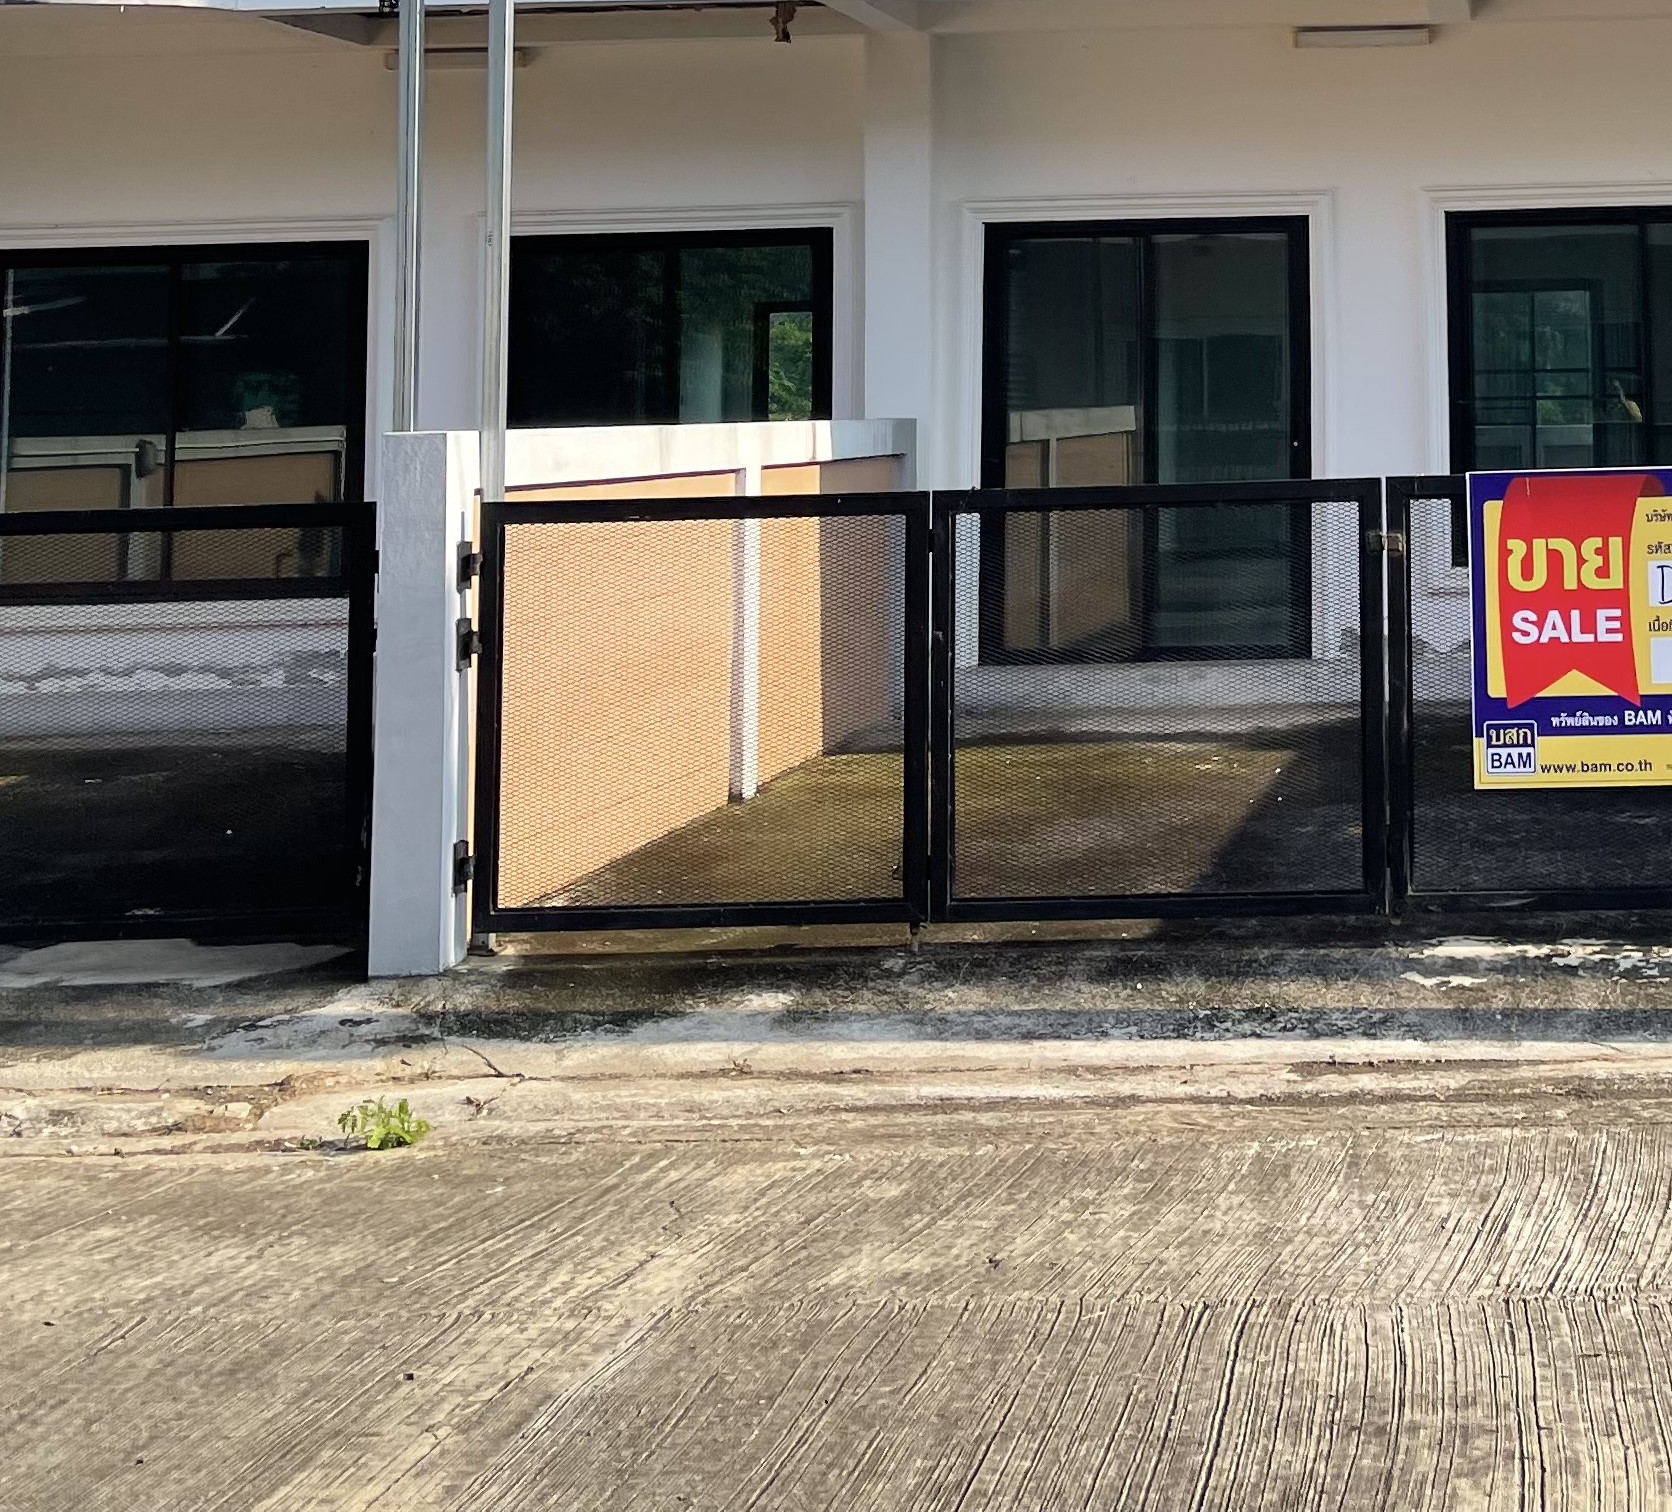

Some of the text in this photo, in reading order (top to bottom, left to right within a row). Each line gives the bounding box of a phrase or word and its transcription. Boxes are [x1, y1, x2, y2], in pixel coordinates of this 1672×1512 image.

[1506, 536, 1624, 592] ขาย
[1511, 608, 1624, 644] SALE
[1624, 710, 1662, 726] BAM
[1489, 727, 1532, 746] บสก
[1490, 751, 1533, 769] BAM
[1540, 759, 1653, 774] www.bam.co.th
